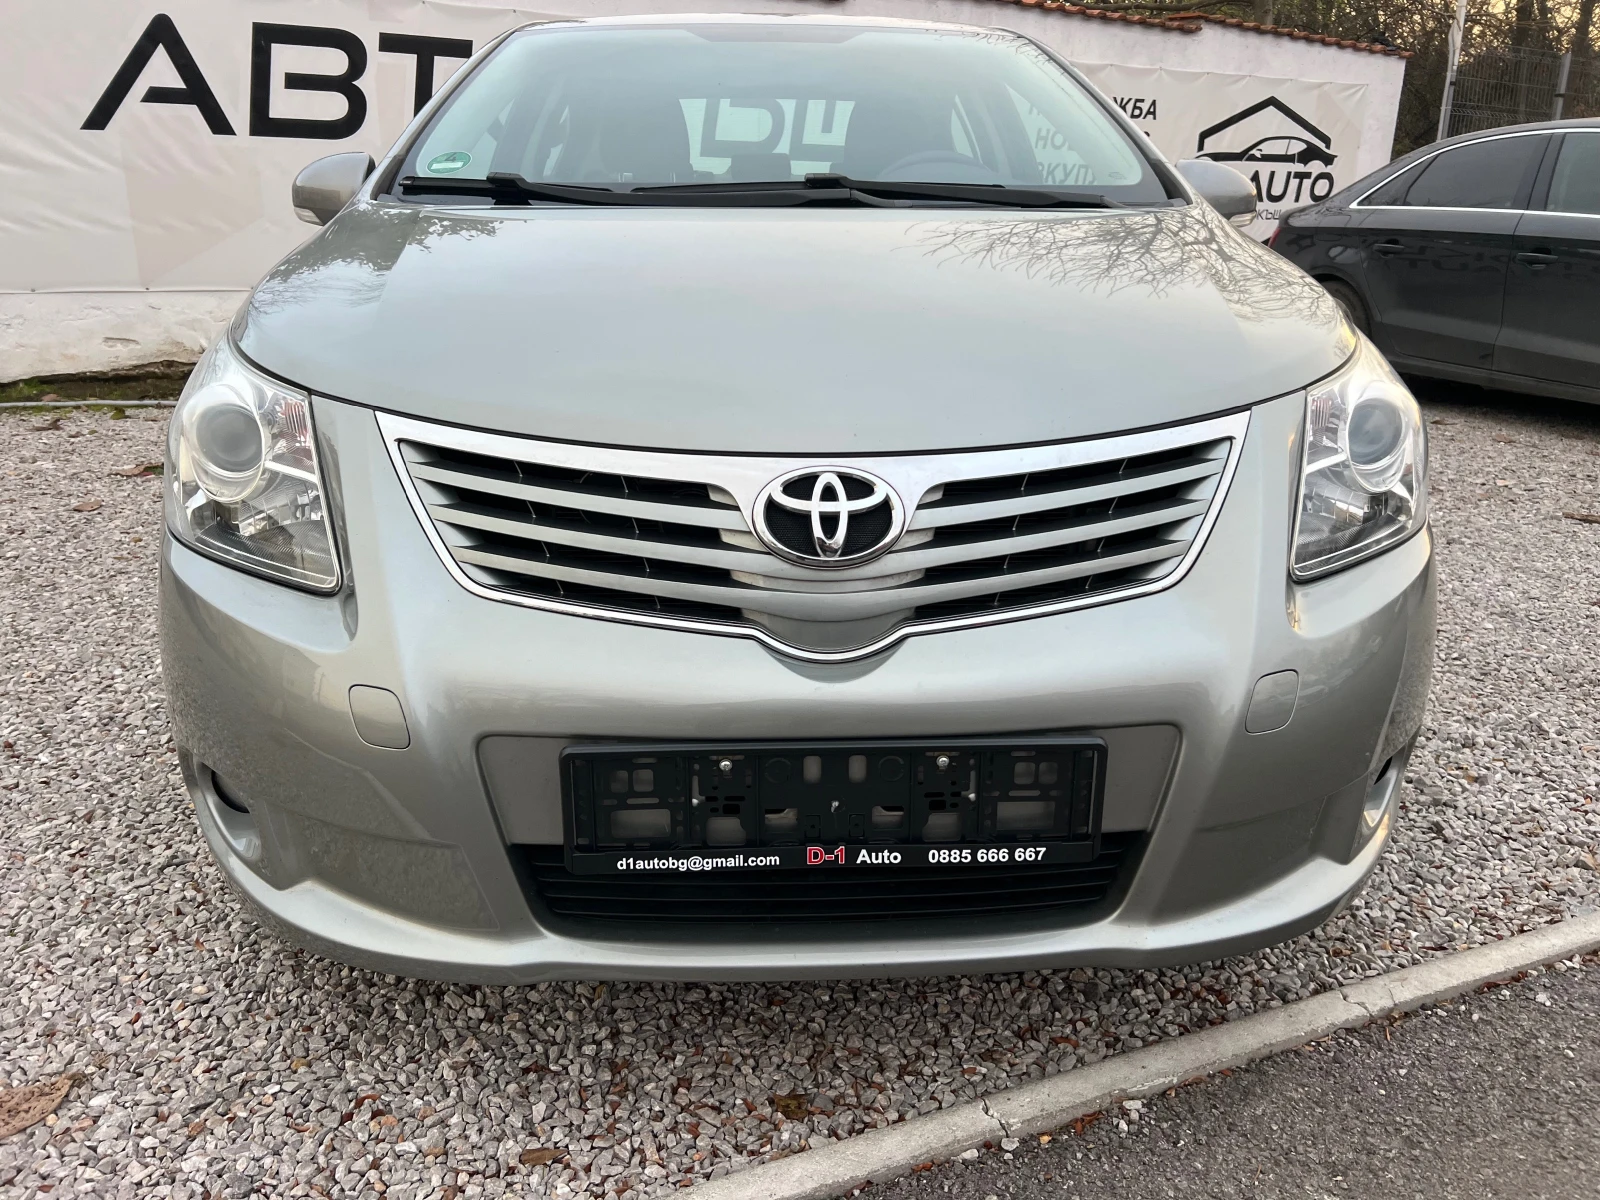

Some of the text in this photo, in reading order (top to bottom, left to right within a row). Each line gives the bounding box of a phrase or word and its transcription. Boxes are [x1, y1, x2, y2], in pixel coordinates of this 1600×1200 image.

[1249, 169, 1335, 204] AUTO
[616, 845, 1048, 871] d1autobg@gmail.com D-1 Auto 0885 666 667
